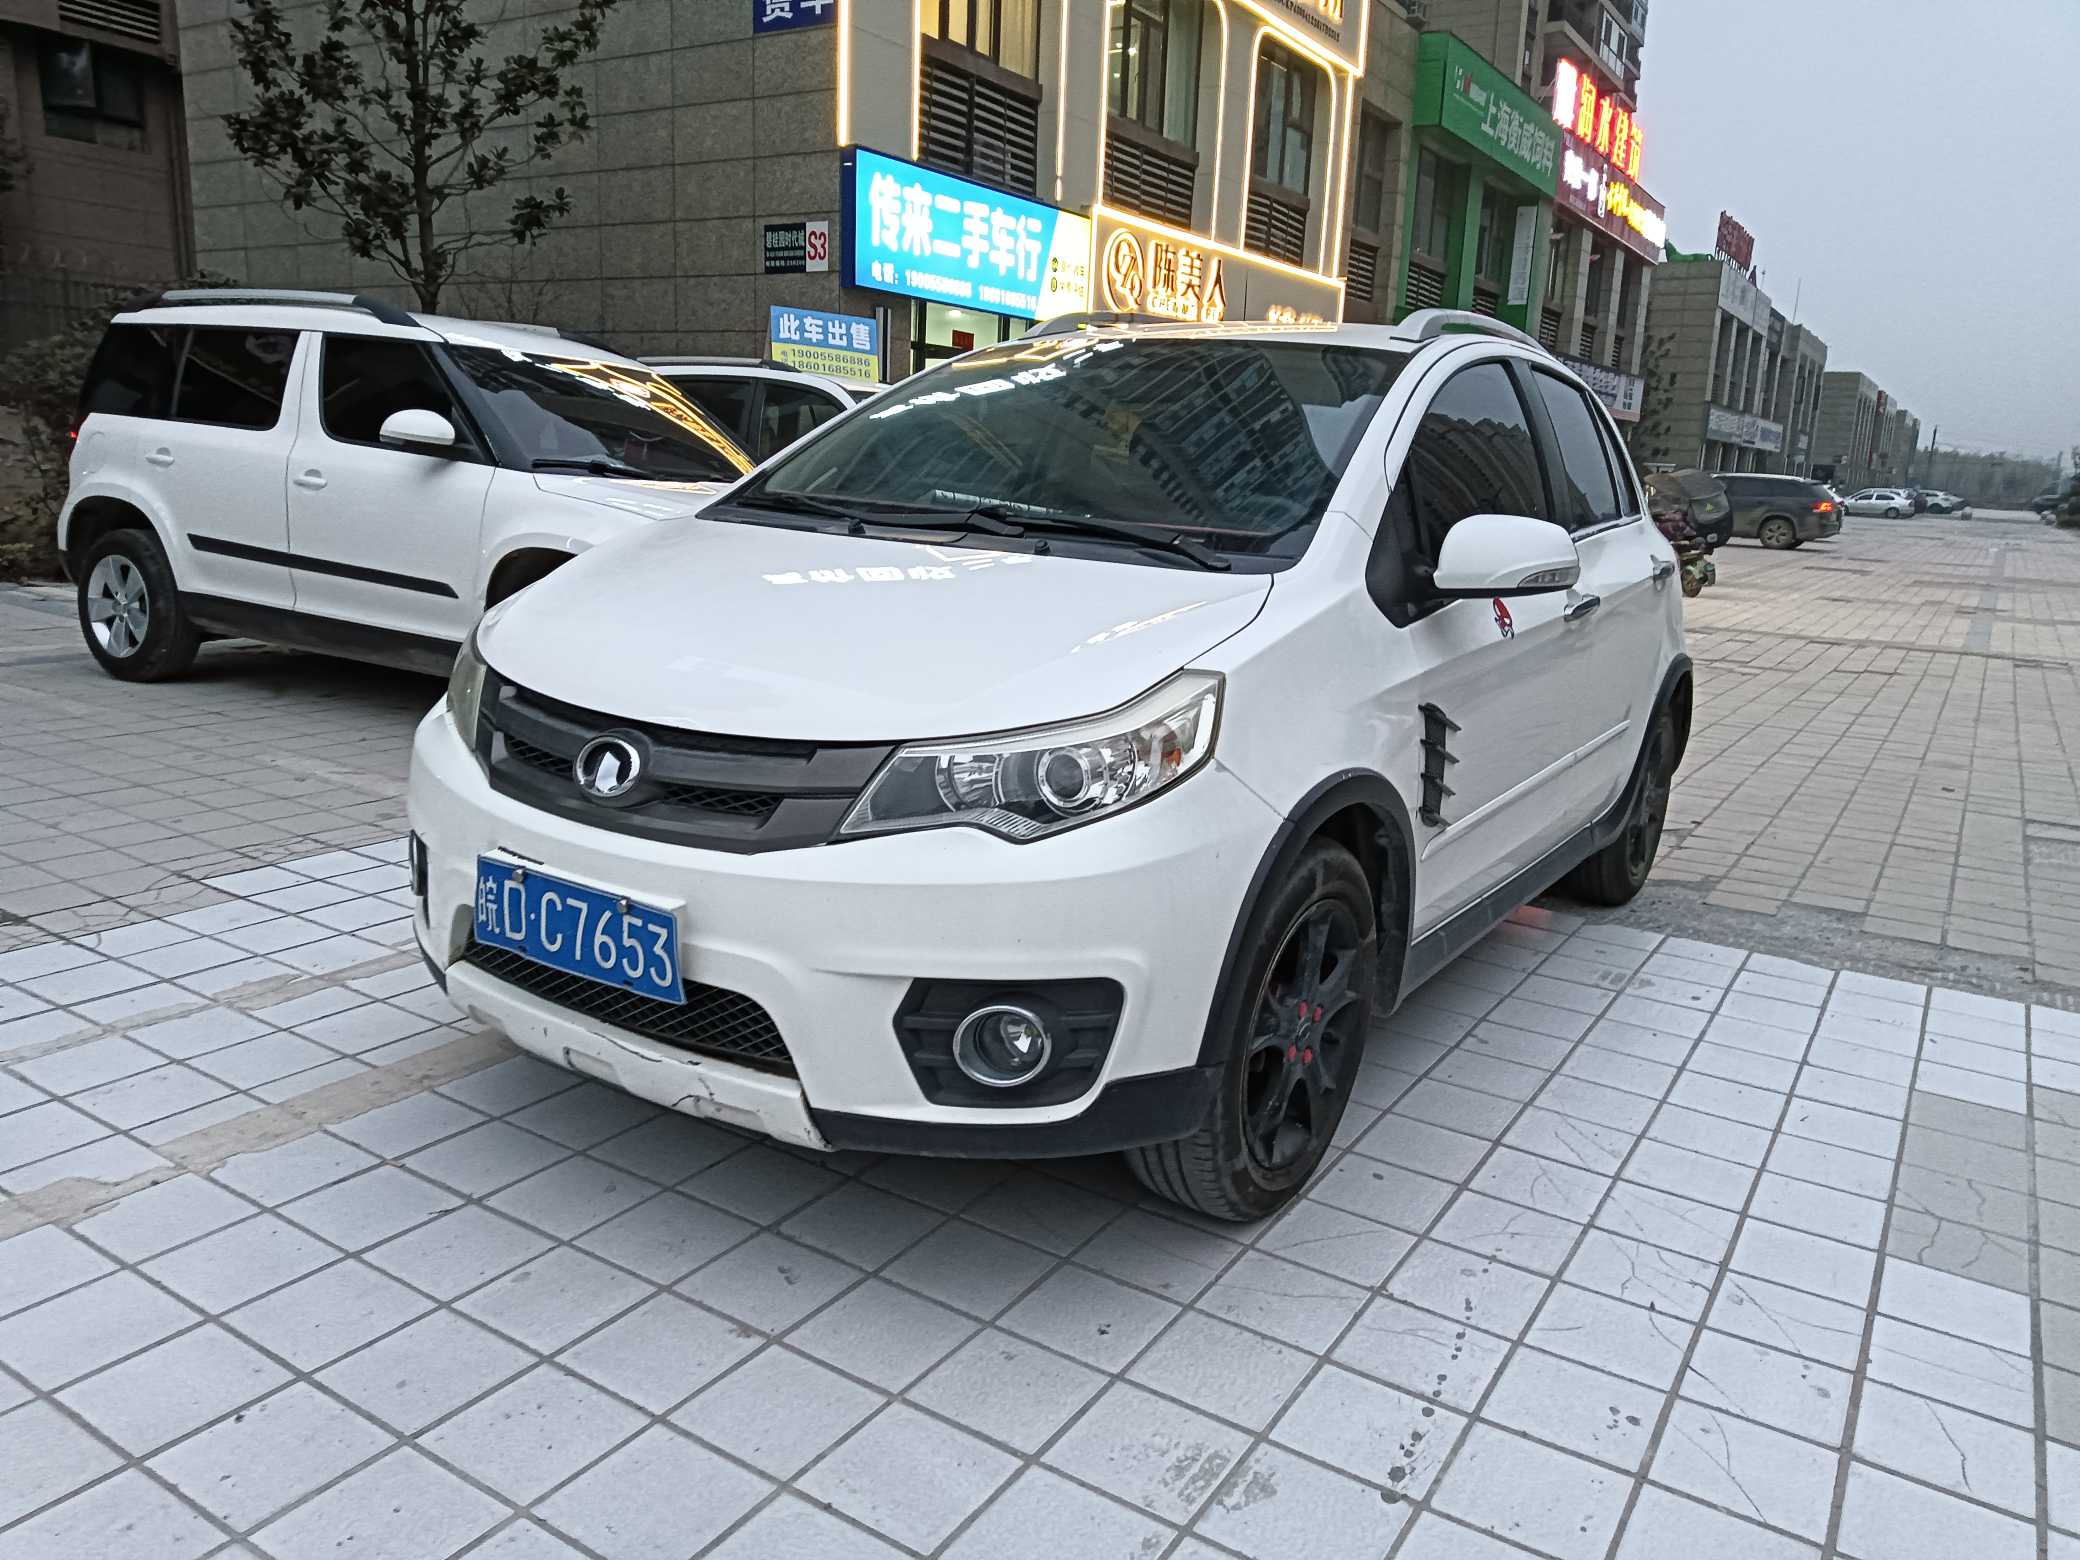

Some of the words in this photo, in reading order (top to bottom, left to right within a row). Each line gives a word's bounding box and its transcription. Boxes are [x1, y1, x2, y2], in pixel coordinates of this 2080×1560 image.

[869, 171, 1042, 282] 传来二手车行
[807, 230, 827, 261] S3
[1152, 241, 1226, 307] 陈美人
[779, 313, 871, 350] 此车出售
[792, 348, 871, 367] 19005586886
[792, 360, 871, 378] 18601685516
